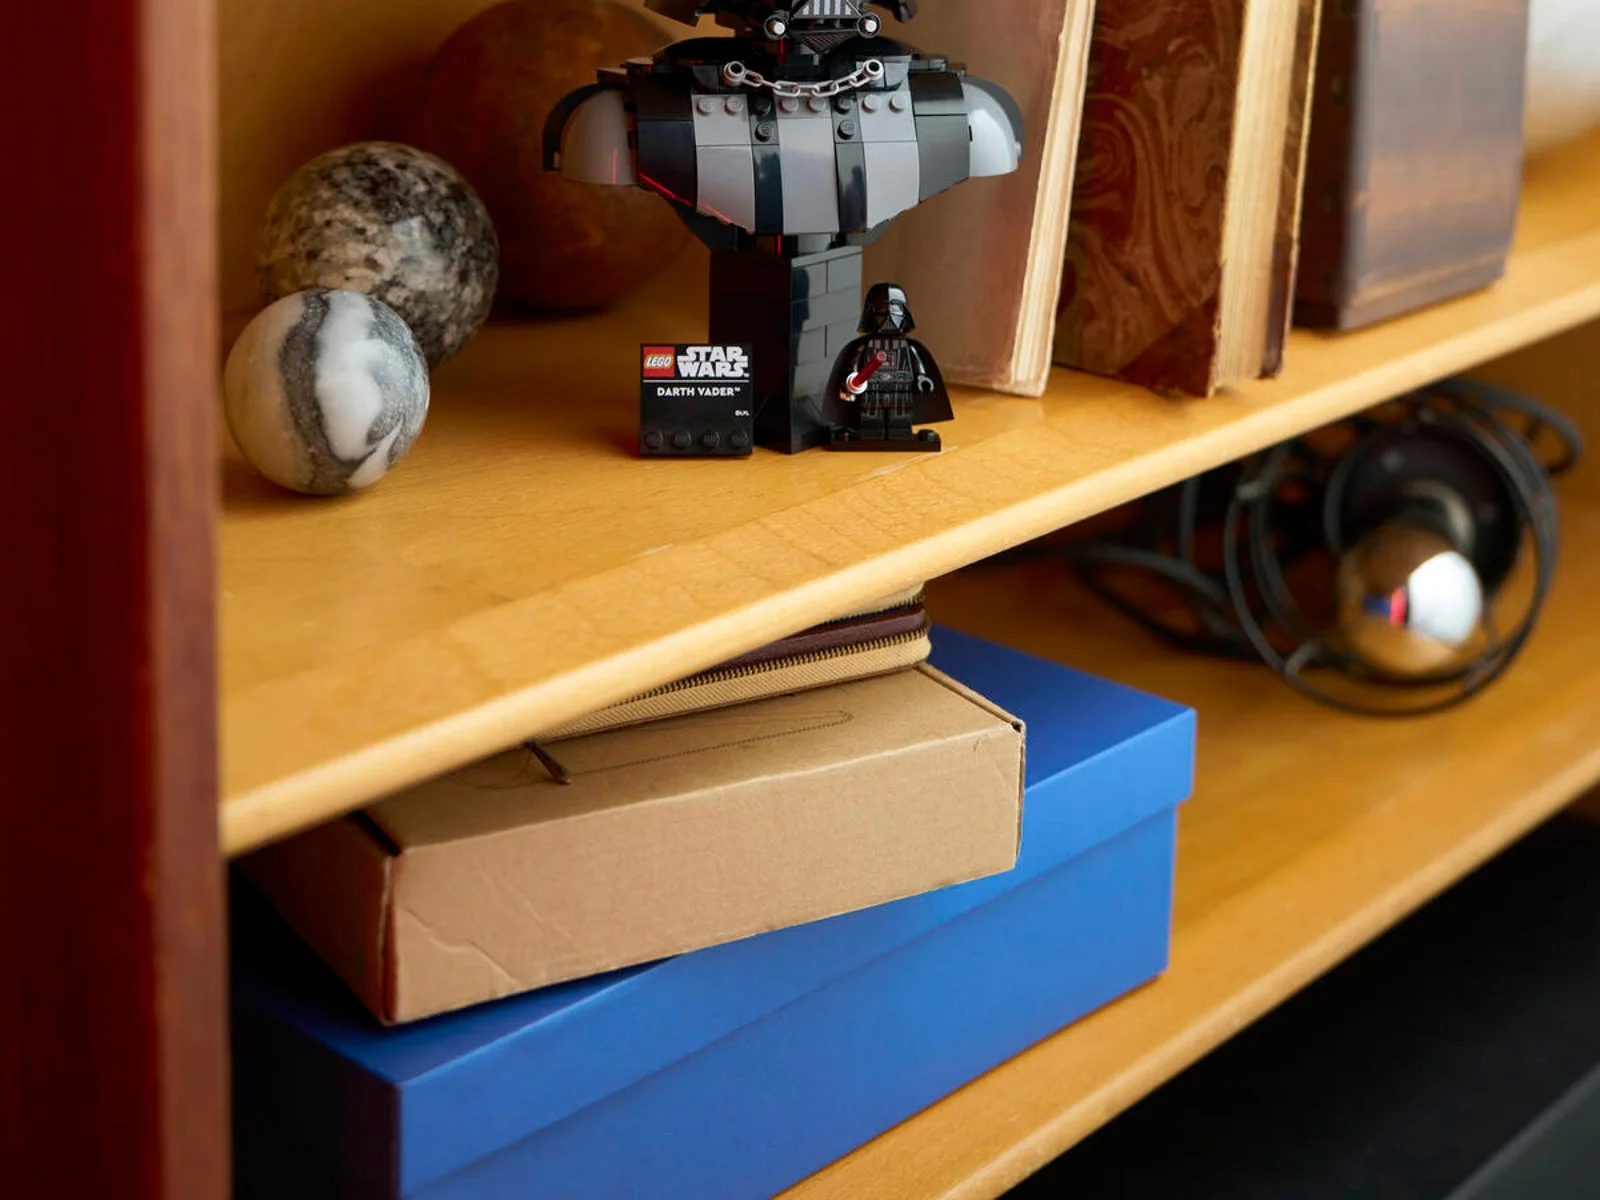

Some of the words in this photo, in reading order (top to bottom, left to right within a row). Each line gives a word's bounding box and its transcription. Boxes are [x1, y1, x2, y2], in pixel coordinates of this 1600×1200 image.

[677, 346, 748, 362] STAR
[646, 356, 672, 368] LEGO
[677, 361, 748, 377] WARS
[657, 387, 695, 396] DARTH
